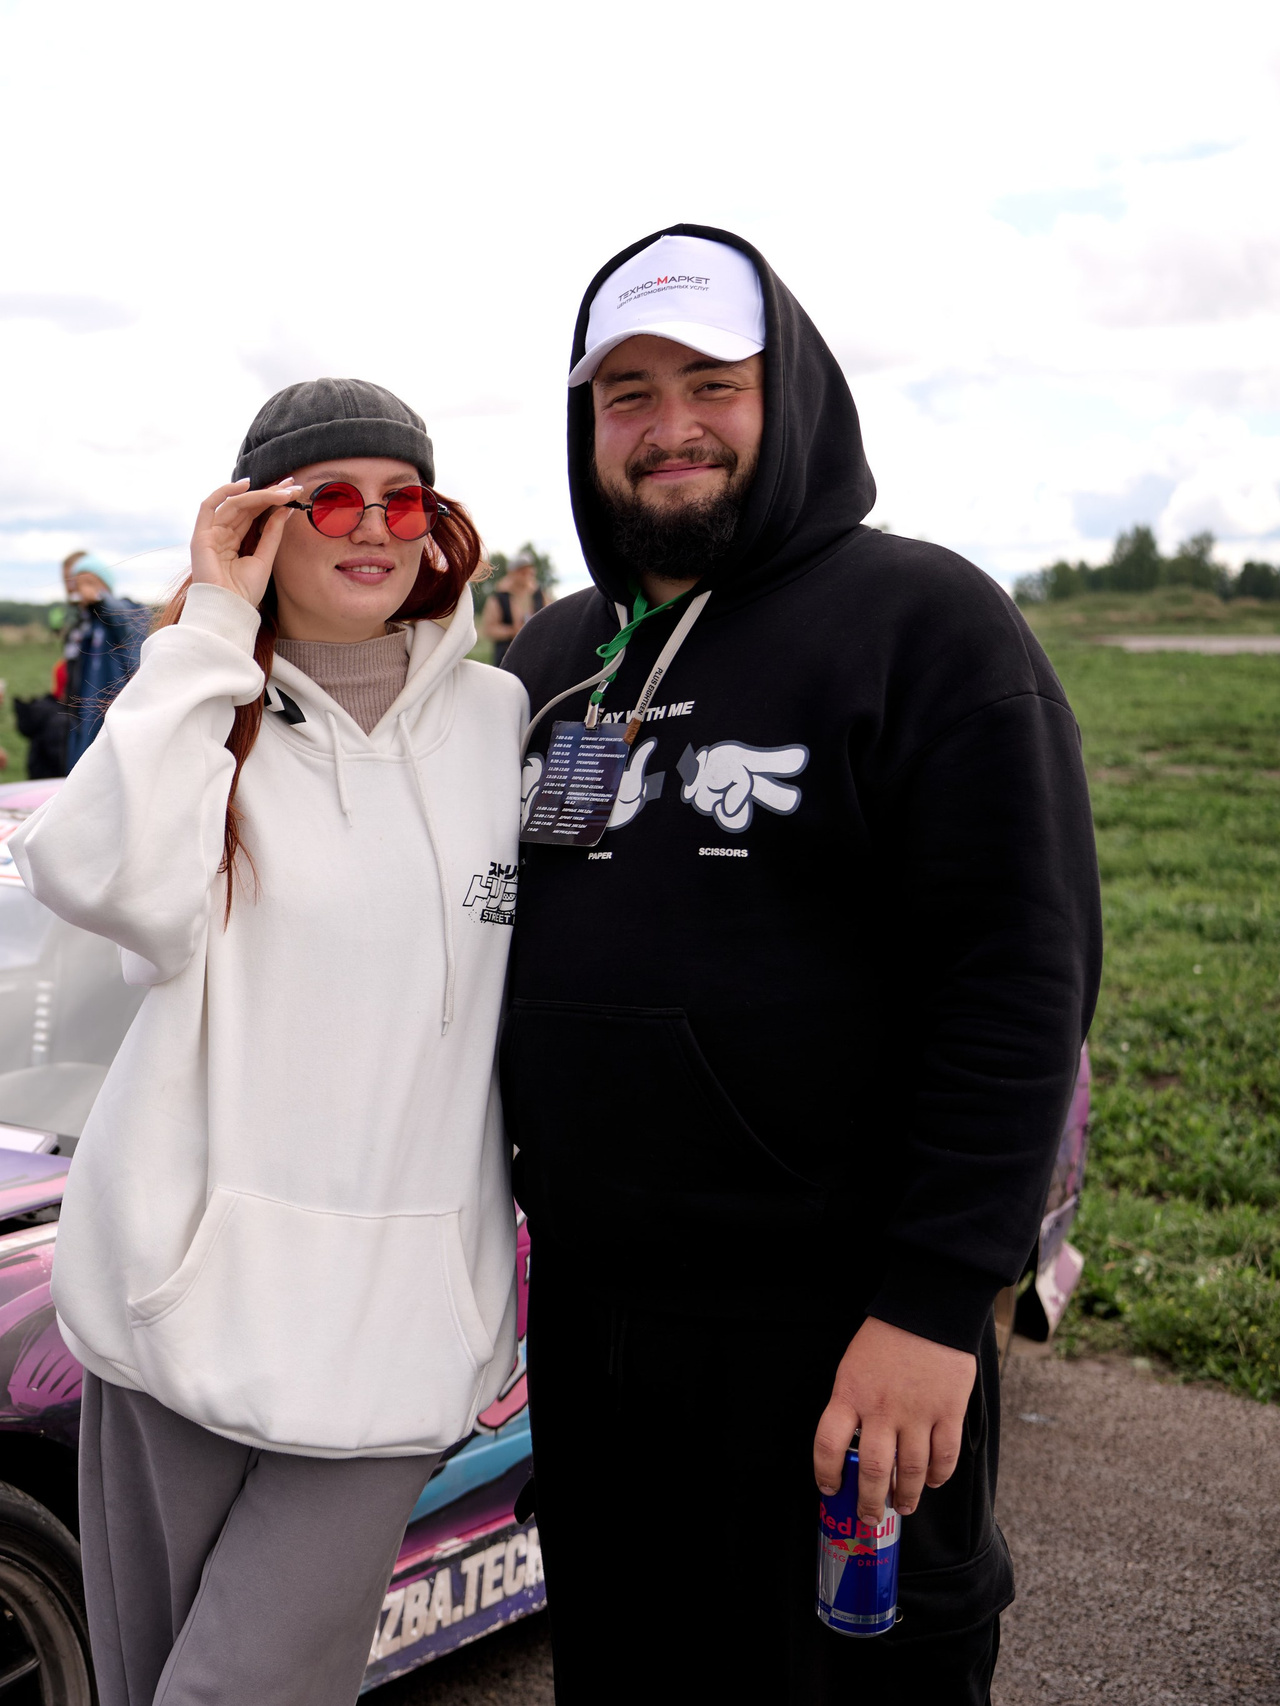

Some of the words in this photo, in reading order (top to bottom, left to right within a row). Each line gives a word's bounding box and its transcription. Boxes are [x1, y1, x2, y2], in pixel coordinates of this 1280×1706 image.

[618, 276, 710, 302] ТЕХНО-МАРКЕТ
[650, 667, 663, 686] PLUS
[626, 706, 667, 722] WTH
[667, 700, 695, 718] ME
[638, 684, 656, 716] EIGHTEEN
[588, 852, 612, 860] PAPER
[698, 848, 748, 858] SCISSORS
[482, 910, 511, 924] STREET
[820, 1501, 852, 1536] Red
[856, 1514, 895, 1539] Bull
[819, 1542, 853, 1564] NERGY
